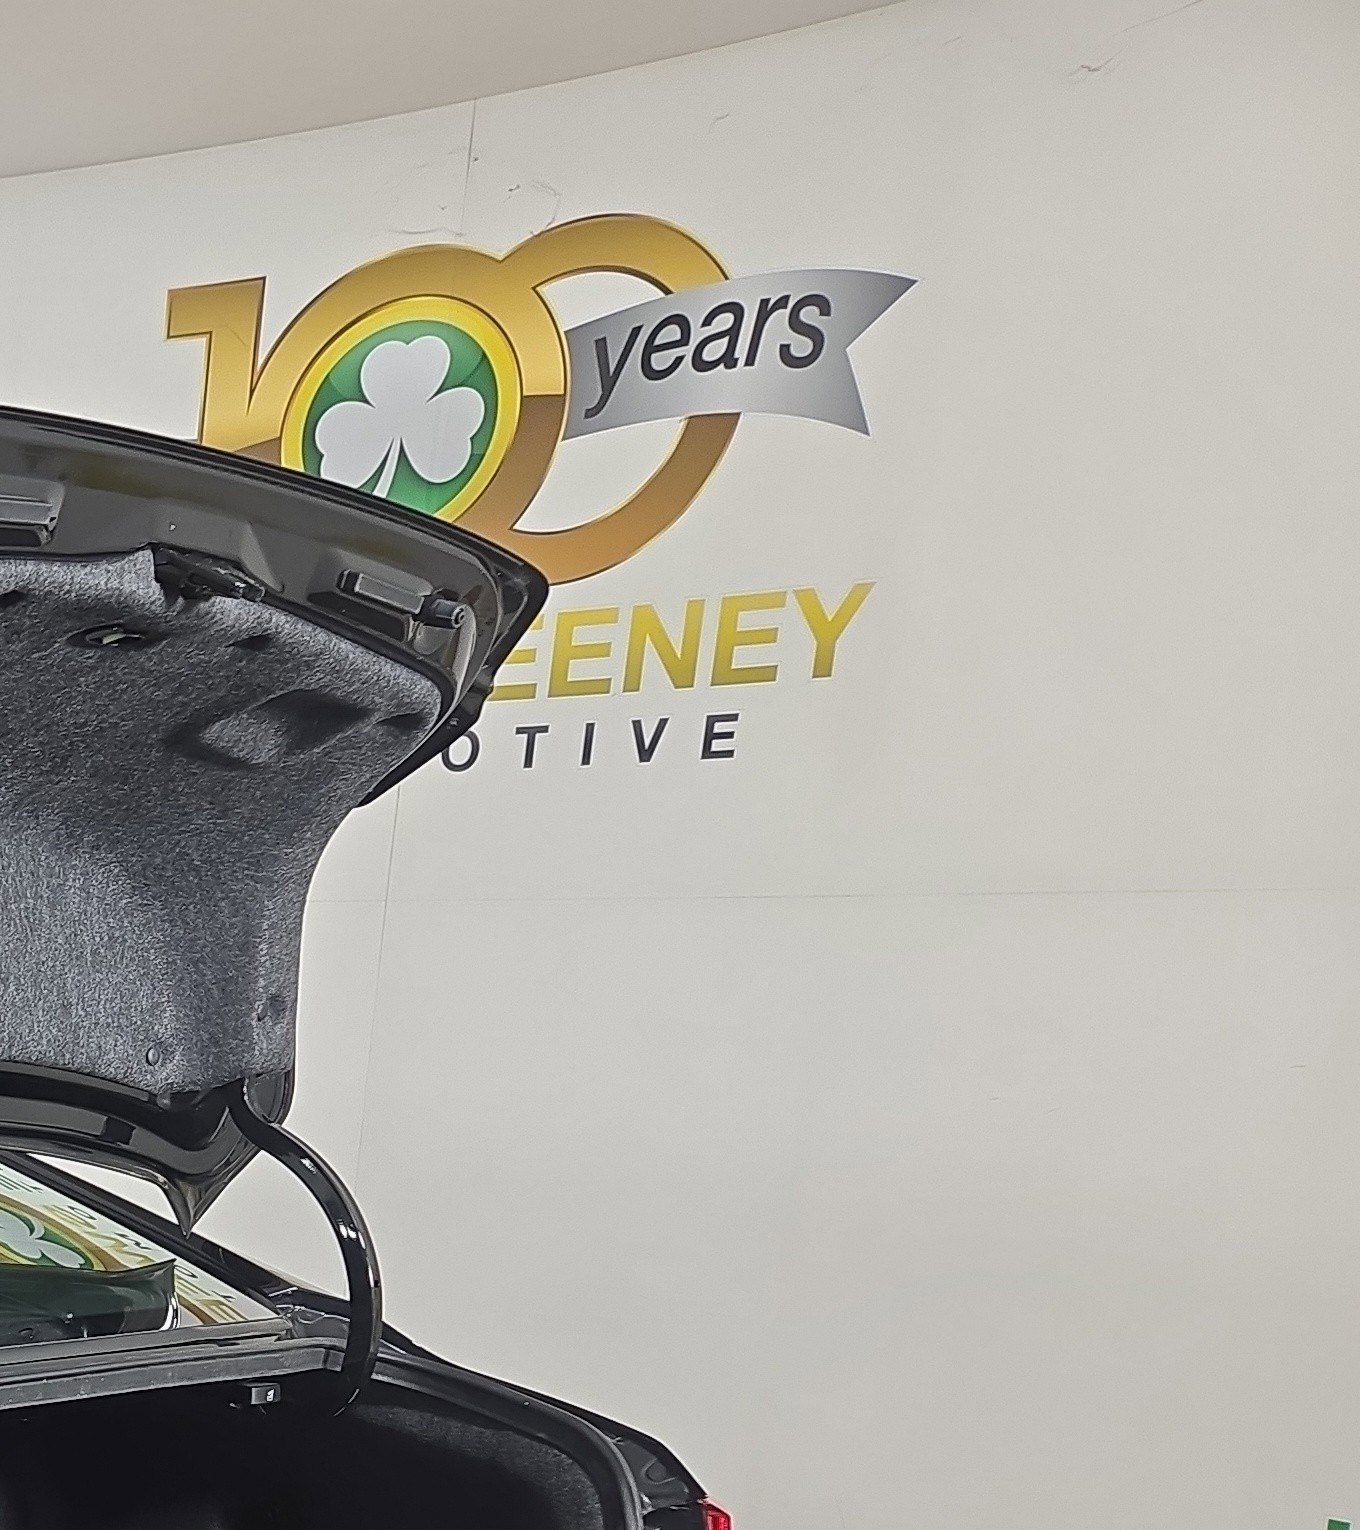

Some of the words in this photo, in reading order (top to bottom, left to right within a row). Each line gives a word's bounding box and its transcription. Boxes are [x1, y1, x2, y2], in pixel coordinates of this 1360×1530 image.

[585, 291, 834, 420] years
[486, 581, 876, 703] EENEY
[441, 711, 740, 772] OTIVE
